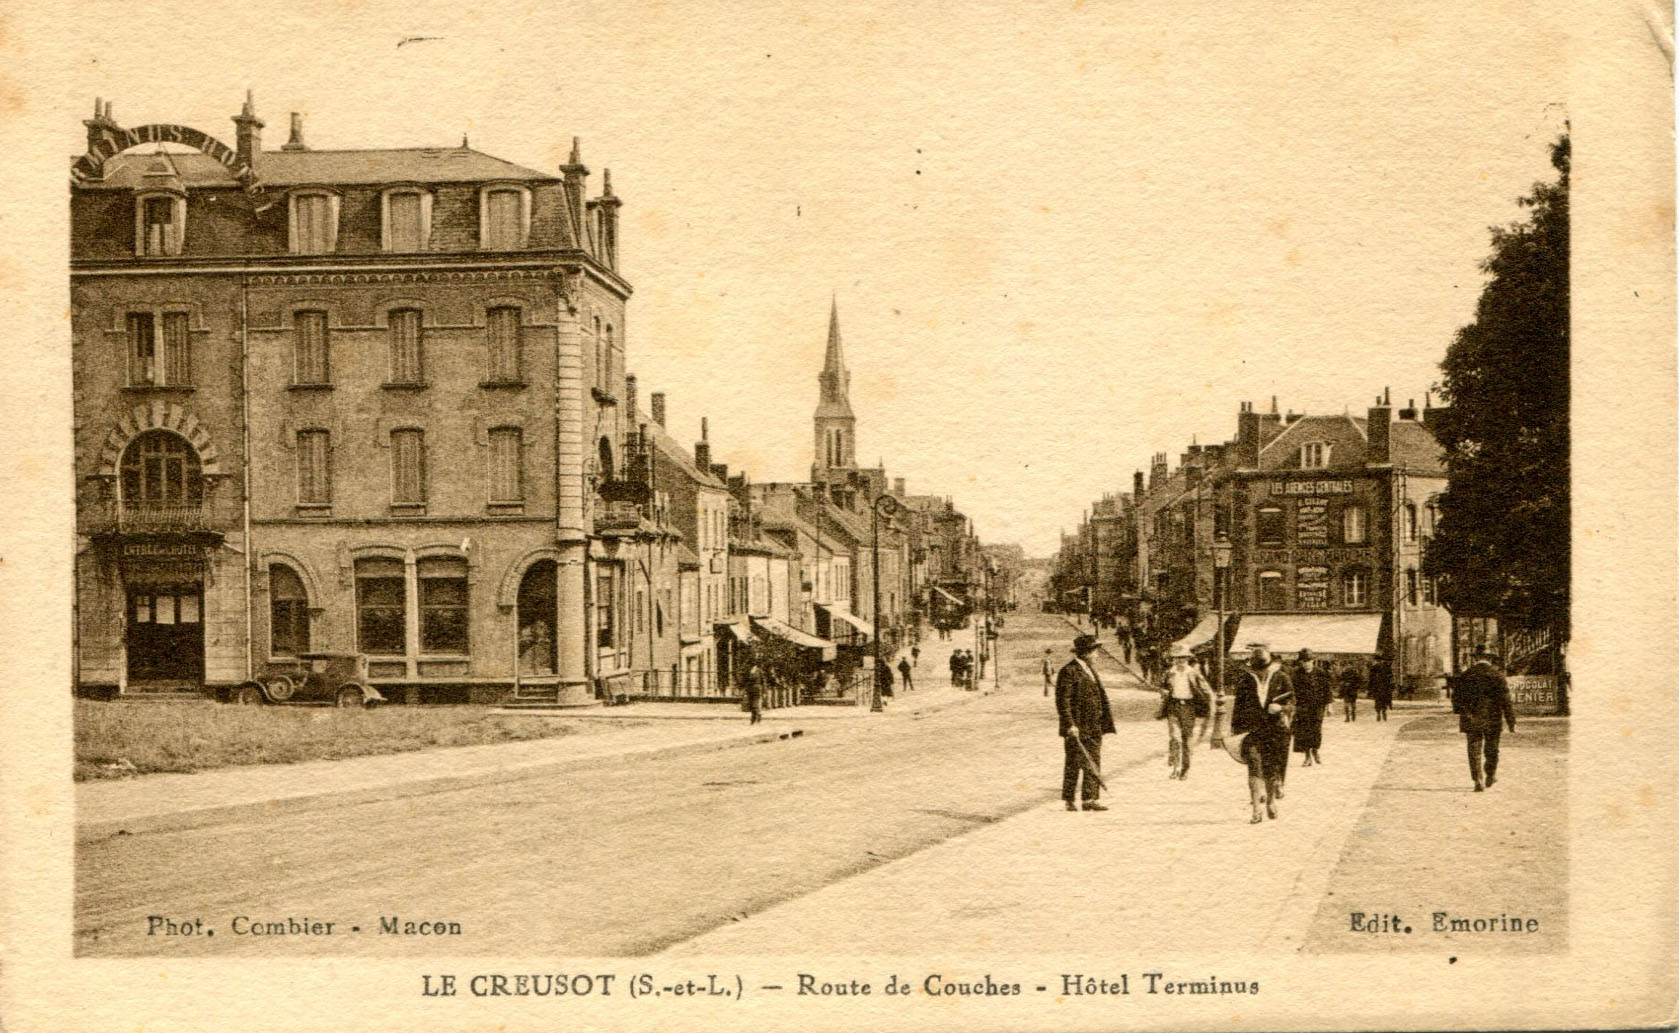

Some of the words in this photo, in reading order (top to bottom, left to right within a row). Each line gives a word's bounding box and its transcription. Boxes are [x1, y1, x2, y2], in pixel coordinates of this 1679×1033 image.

[1271, 481, 1284, 495] LES
[1316, 479, 1353, 494] CENTRALES
[1508, 679, 1553, 690] CHOCOLAT
